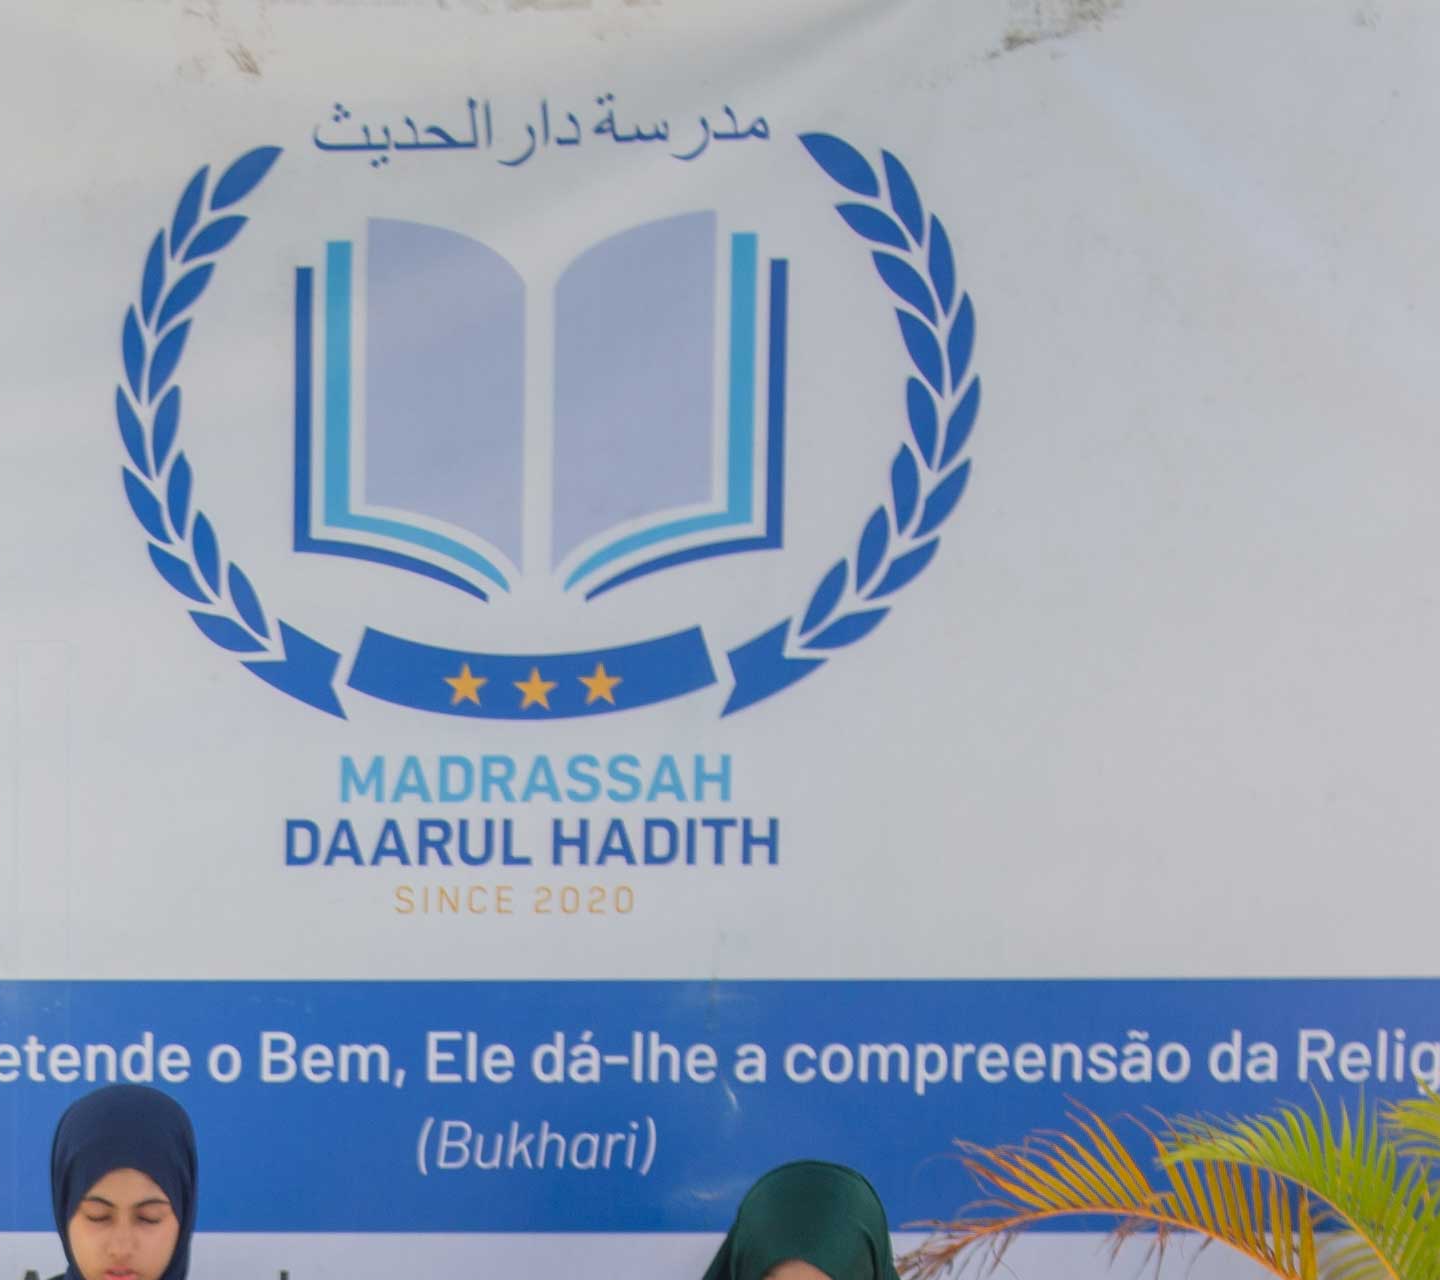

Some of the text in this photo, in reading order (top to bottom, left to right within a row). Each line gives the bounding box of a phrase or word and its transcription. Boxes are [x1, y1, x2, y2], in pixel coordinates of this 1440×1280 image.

[312, 92, 771, 169] مدرسة دار الحديث
[339, 754, 733, 803] MADRASSAH
[284, 817, 780, 866] DAARUL HADITH
[394, 885, 635, 915] SINCE 2020
[208, 1041, 243, 1083] o
[260, 1030, 407, 1090] Bem,
[425, 1030, 514, 1083] Ele
[531, 1028, 719, 1084] dá-lhe
[735, 1041, 767, 1083] a
[784, 1031, 1191, 1095] compreensão
[1208, 1029, 1279, 1083] da
[415, 1116, 658, 1177] (Bukhari)
